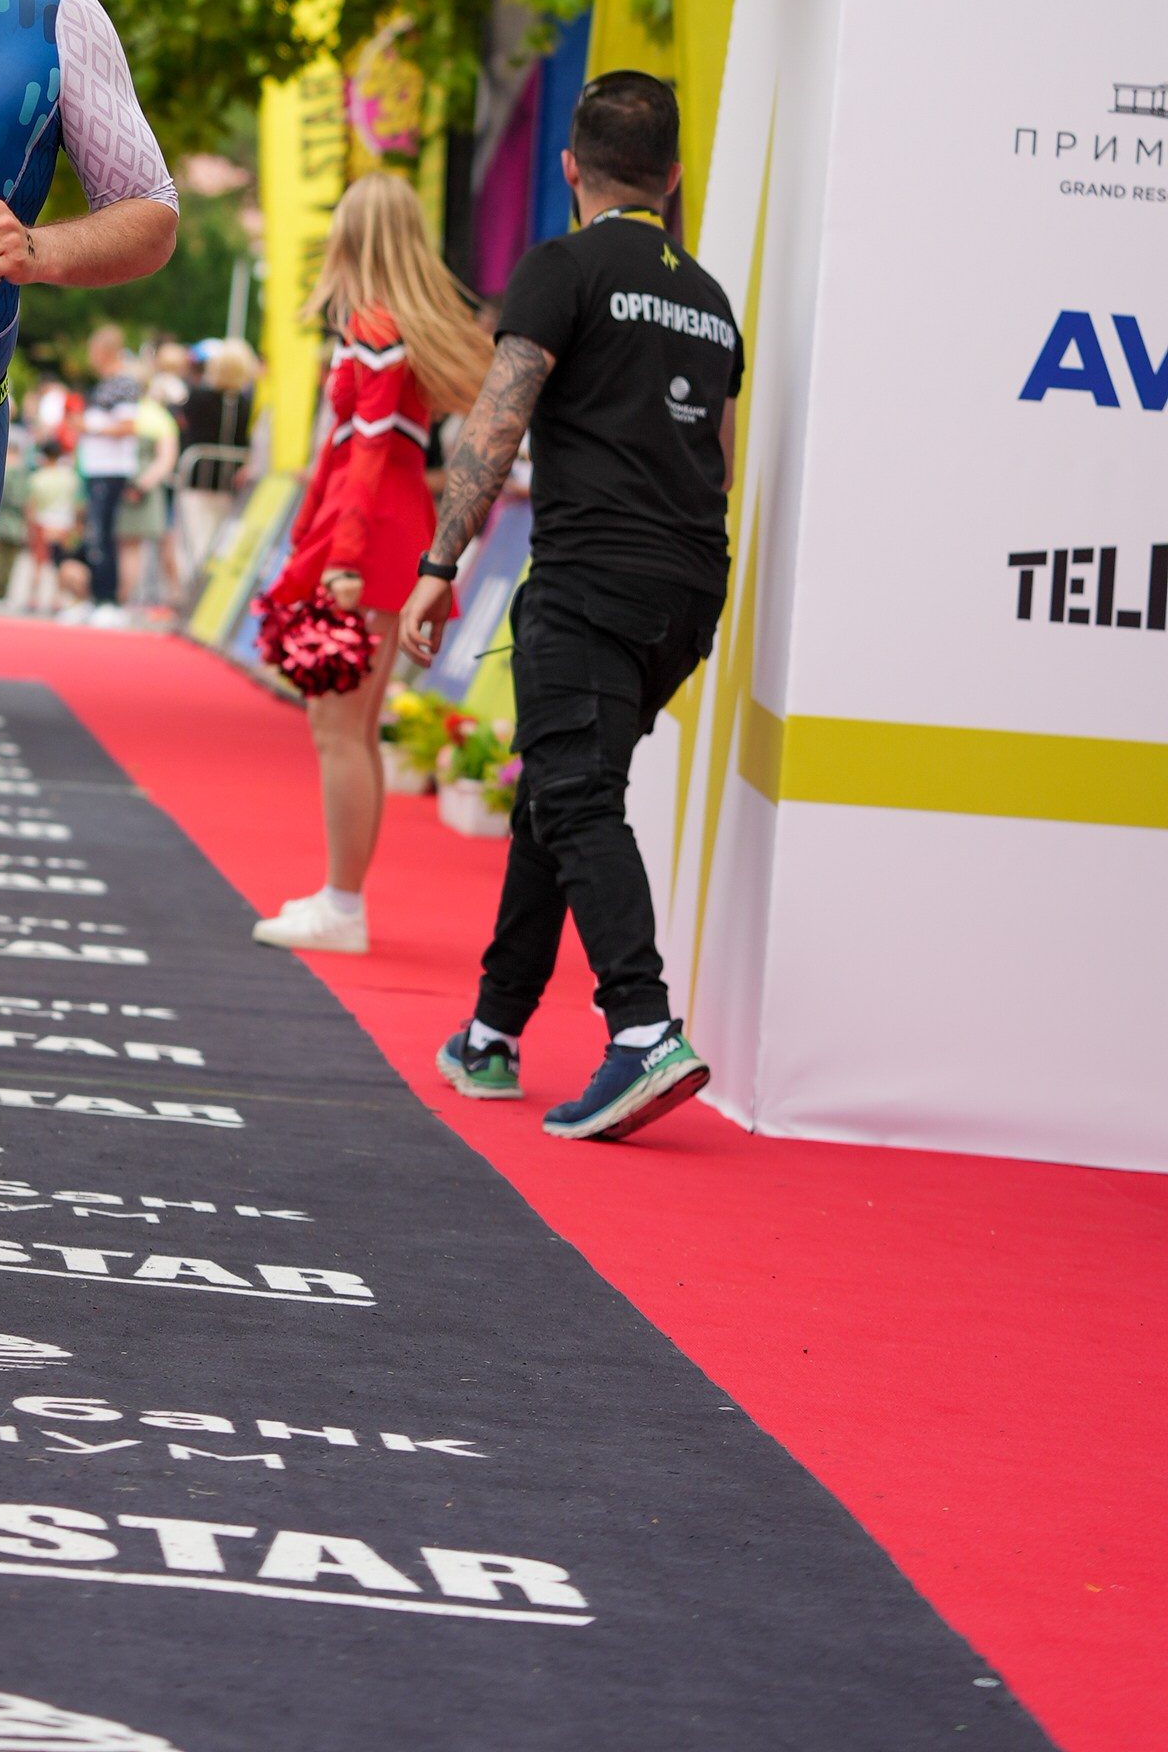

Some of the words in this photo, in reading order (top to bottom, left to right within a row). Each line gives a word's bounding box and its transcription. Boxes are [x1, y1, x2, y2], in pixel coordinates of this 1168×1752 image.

[1014, 128, 1163, 166] ПРИМ
[1059, 180, 1126, 199] GRAND
[609, 291, 736, 352] ОРГАНИЗАТОР
[641, 1036, 681, 1072] HOKA
